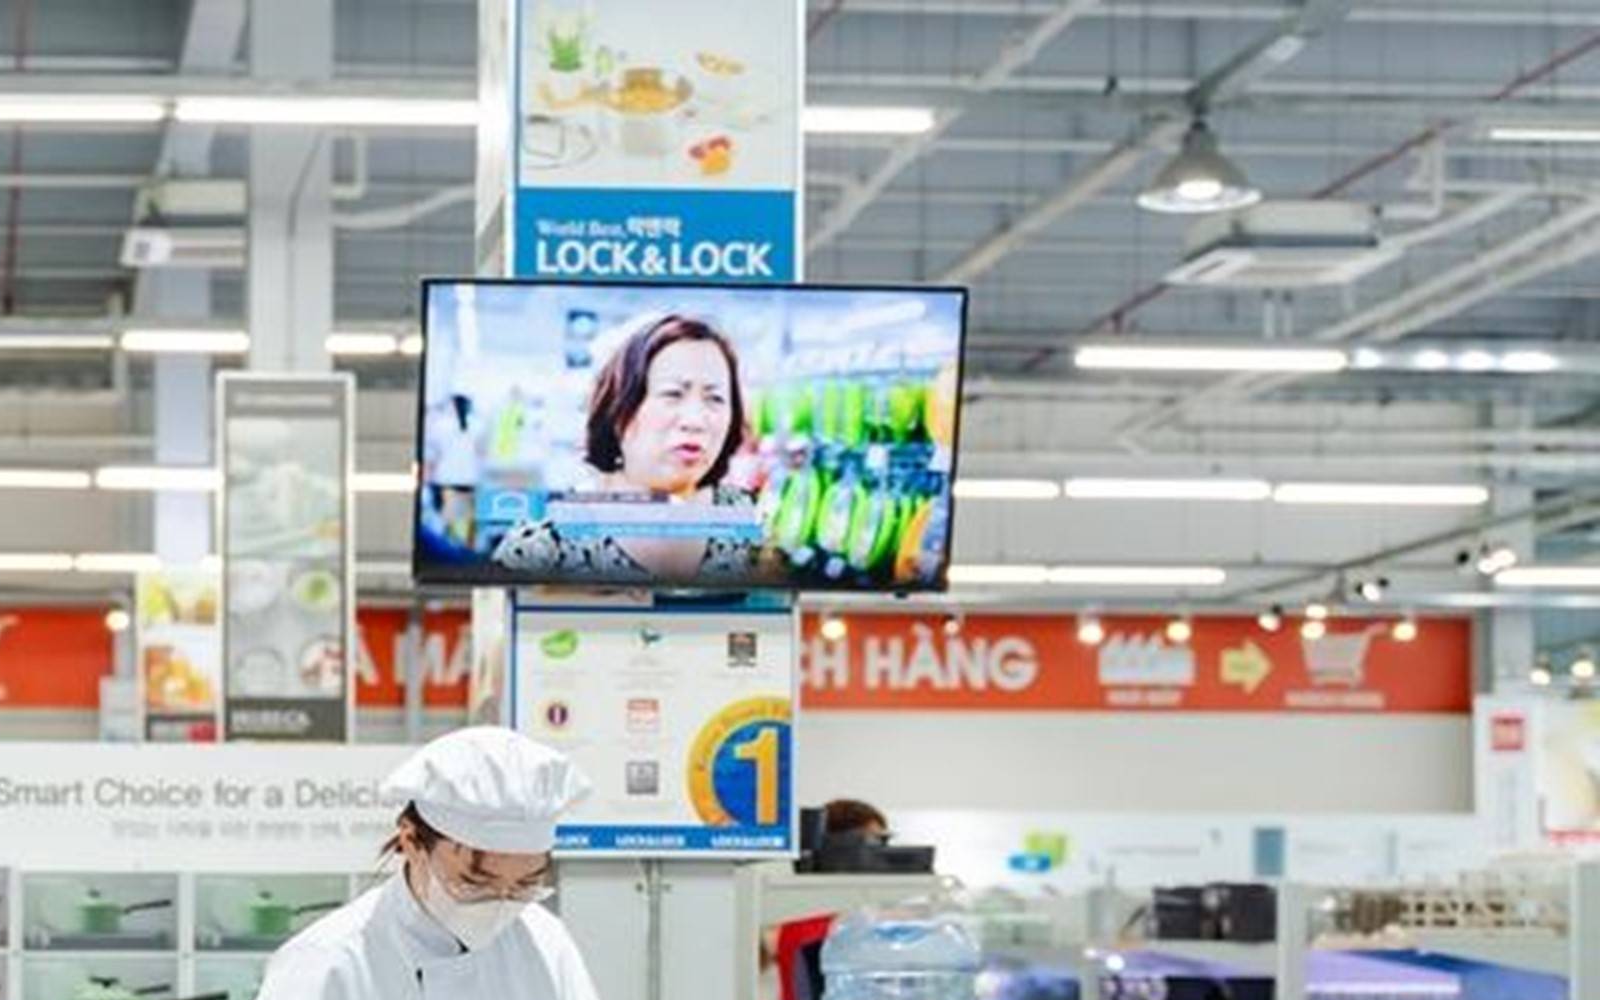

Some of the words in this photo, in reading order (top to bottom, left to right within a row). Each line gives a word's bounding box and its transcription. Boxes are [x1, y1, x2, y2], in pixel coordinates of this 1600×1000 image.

[536, 240, 773, 276] LOCK&LOCK
[863, 621, 1040, 692] HÀNG
[94, 777, 202, 808] Choice
[214, 777, 253, 808] for
[263, 784, 285, 809] a
[734, 726, 777, 825] 1
